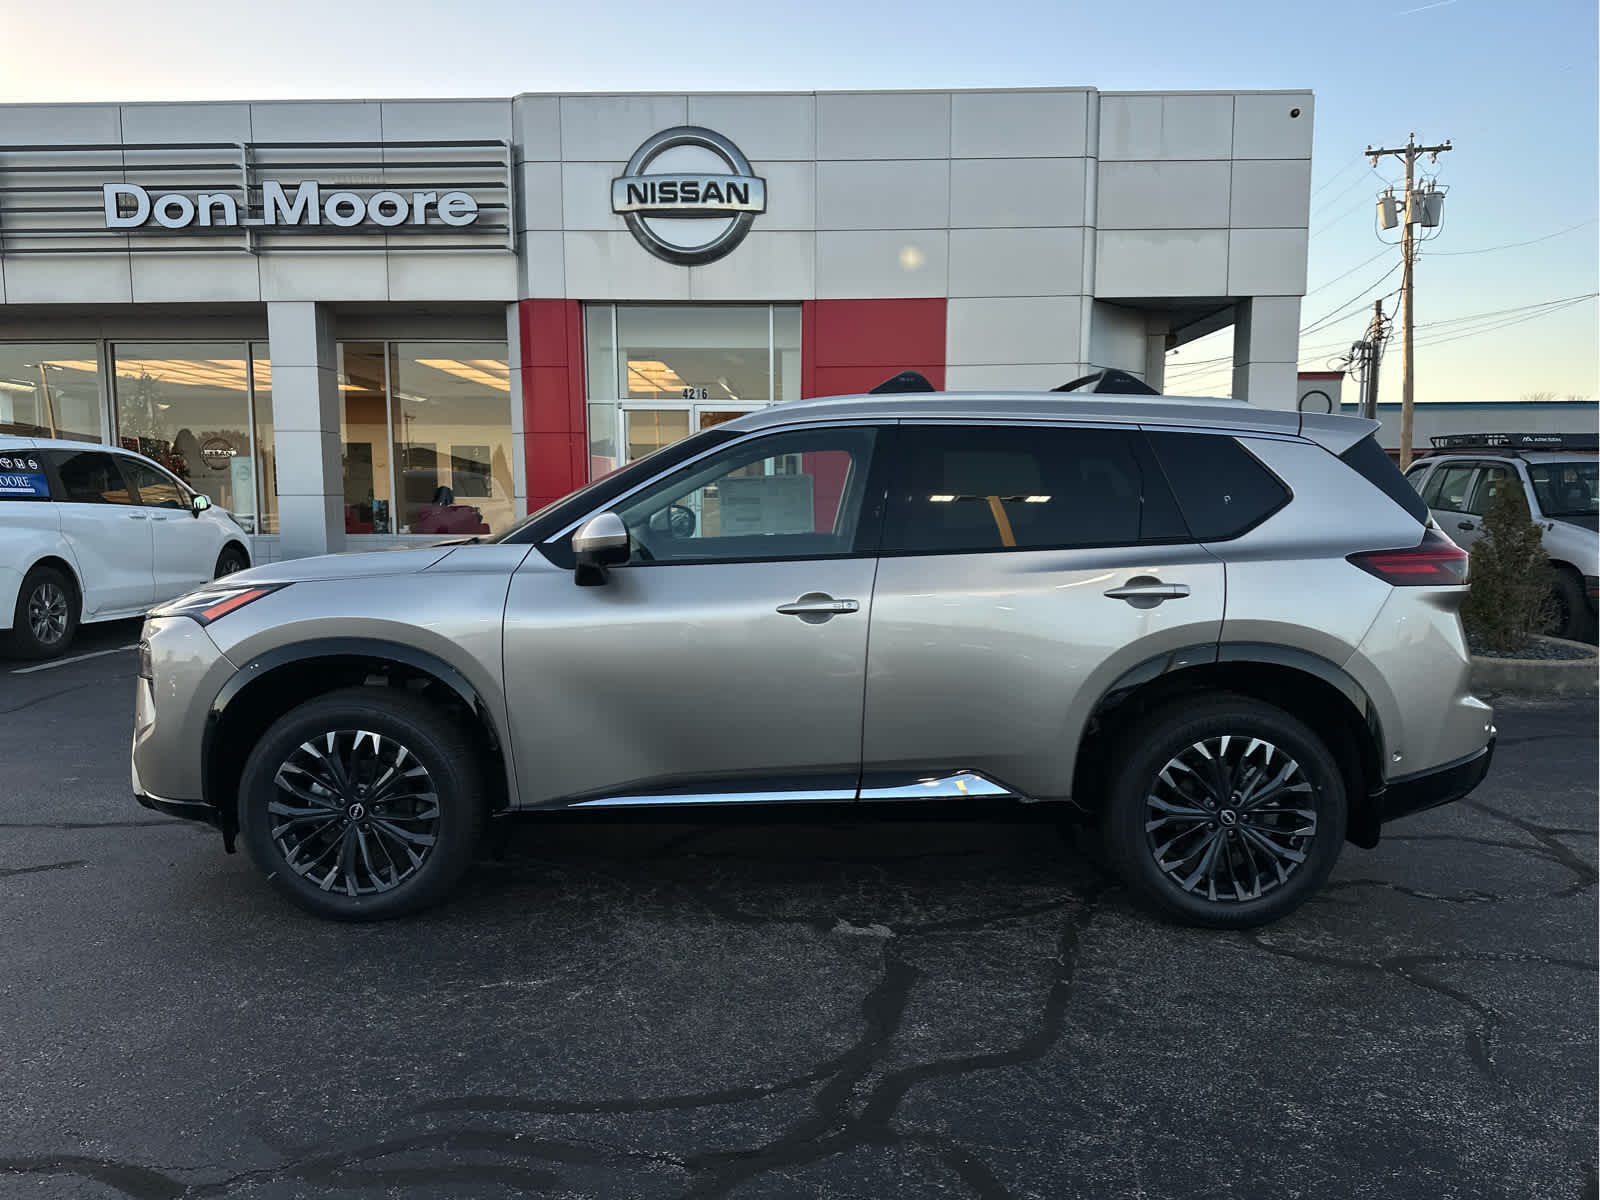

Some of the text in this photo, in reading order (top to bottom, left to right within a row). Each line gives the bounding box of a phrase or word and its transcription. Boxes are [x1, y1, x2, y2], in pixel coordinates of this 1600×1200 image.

[626, 180, 749, 205] NISSAN
[103, 180, 480, 229] Don Moore
[682, 388, 708, 399] 4216
[0, 475, 31, 487] OORE
